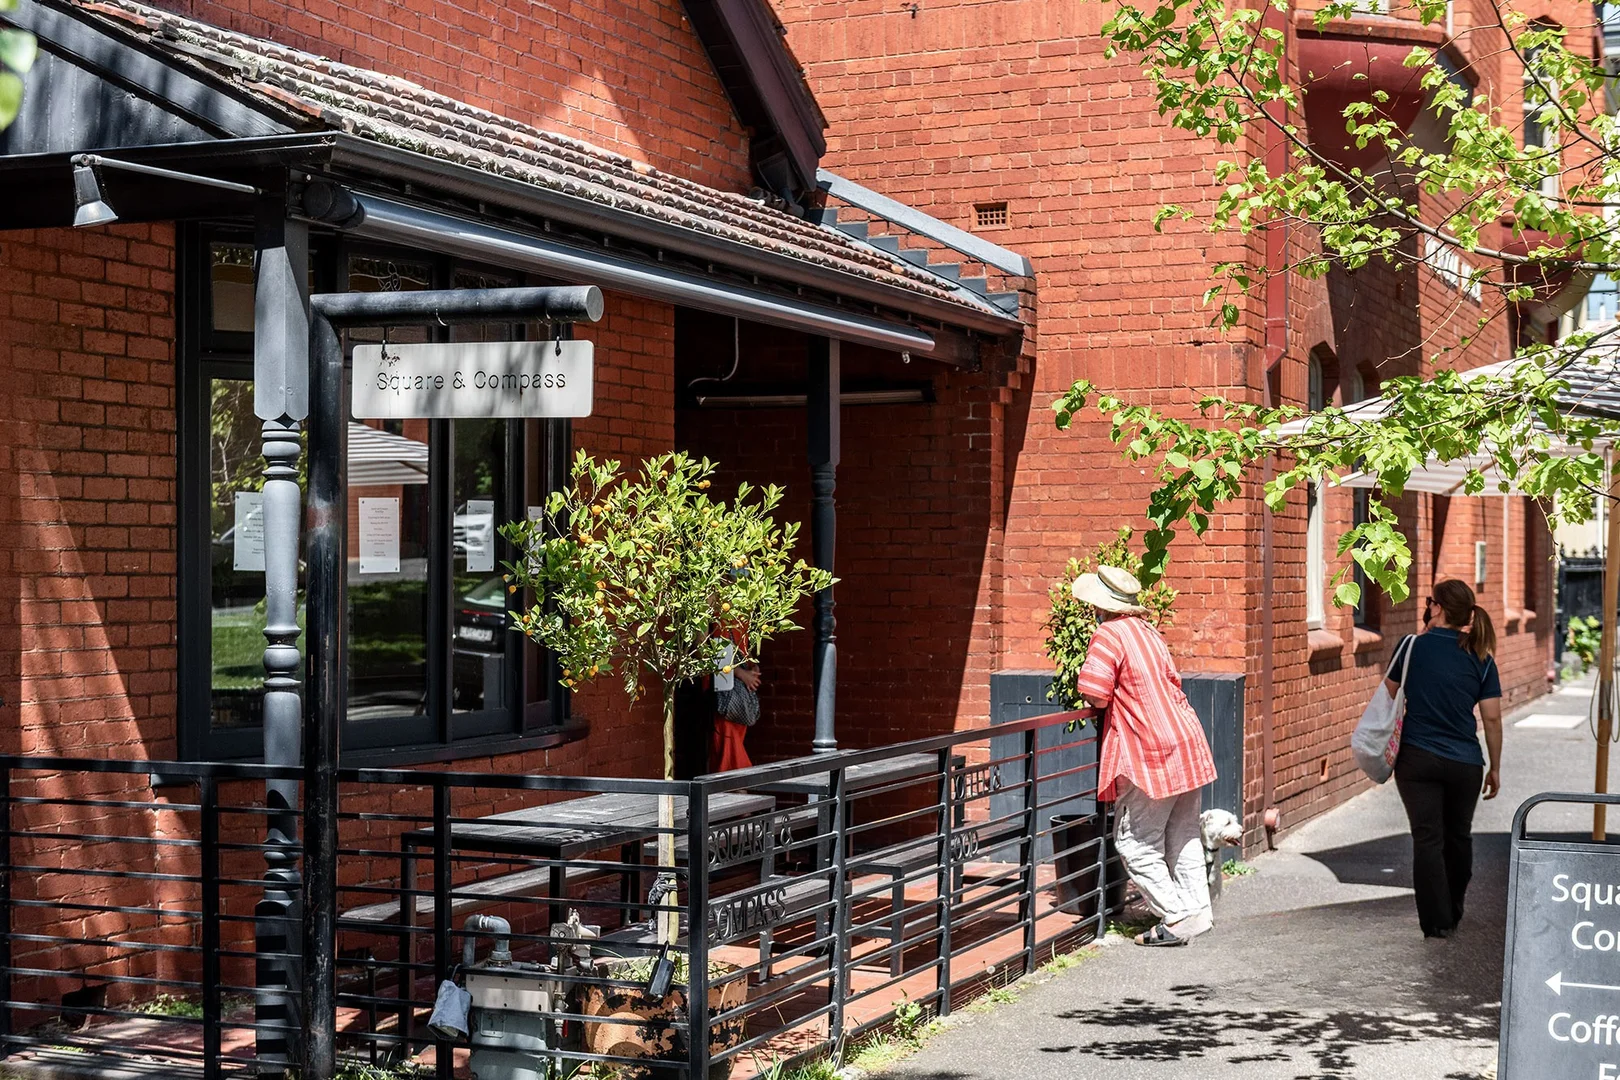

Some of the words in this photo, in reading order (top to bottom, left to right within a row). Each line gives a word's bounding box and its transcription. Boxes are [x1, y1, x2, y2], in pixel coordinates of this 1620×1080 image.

[376, 371, 445, 396] Square
[452, 370, 466, 390] &
[473, 370, 567, 395] Compass
[780, 814, 794, 850] &
[1571, 921, 1620, 952] Co
[1547, 1012, 1620, 1046] Coff
